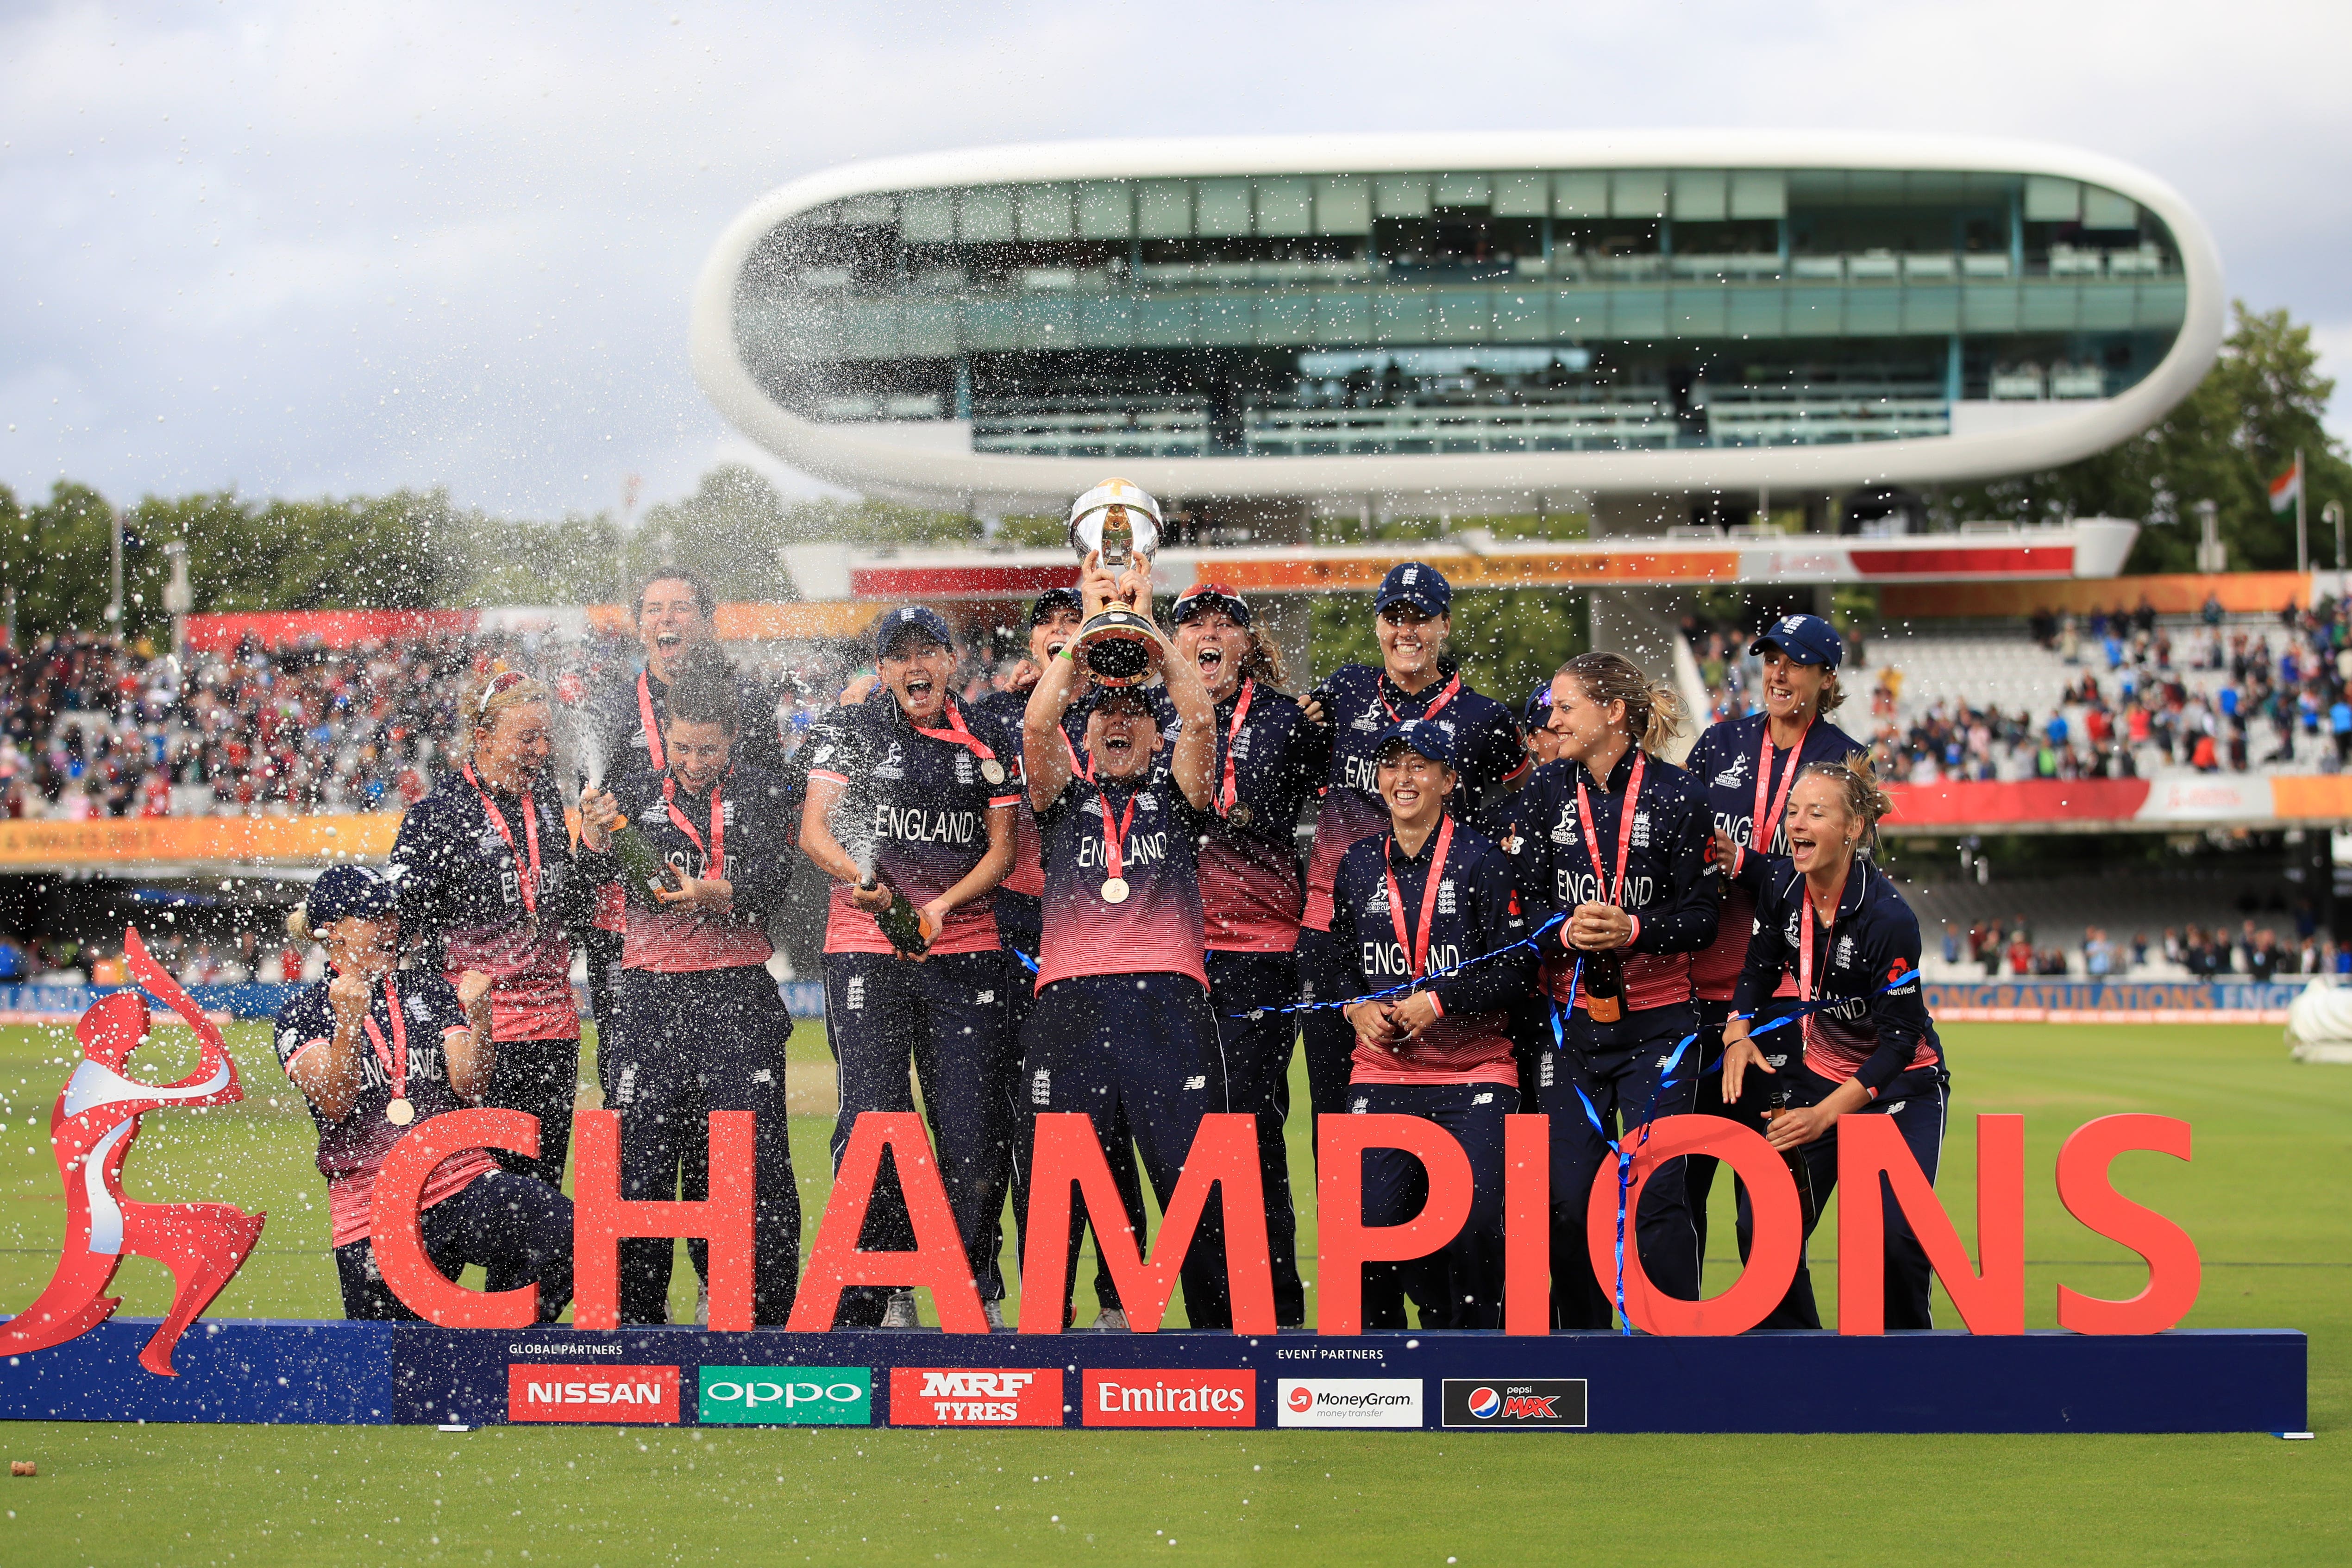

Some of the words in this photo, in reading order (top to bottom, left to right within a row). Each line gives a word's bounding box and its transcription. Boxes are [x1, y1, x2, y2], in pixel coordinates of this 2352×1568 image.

[876, 804, 974, 843] ENGLAND
[1887, 985, 1916, 996] NatWest
[369, 1108, 2201, 1336] CHAMPIONS
[508, 1343, 558, 1355] GLOBAL
[561, 1344, 623, 1355] PARTNERS
[1278, 1349, 1317, 1360] EVENT
[1321, 1349, 1384, 1360] PARTNERS
[527, 1383, 661, 1405] NISSAN
[707, 1381, 863, 1408] oppo
[919, 1372, 1033, 1398] MRF
[1506, 1385, 1532, 1395] pepsi
[1097, 1380, 1244, 1412] Emirates
[1317, 1392, 1411, 1407] MoneyGram
[934, 1402, 1018, 1421] TYRES
[1317, 1409, 1347, 1419] money
[1348, 1408, 1384, 1418] transfer
[1501, 1395, 1562, 1418] MAX
